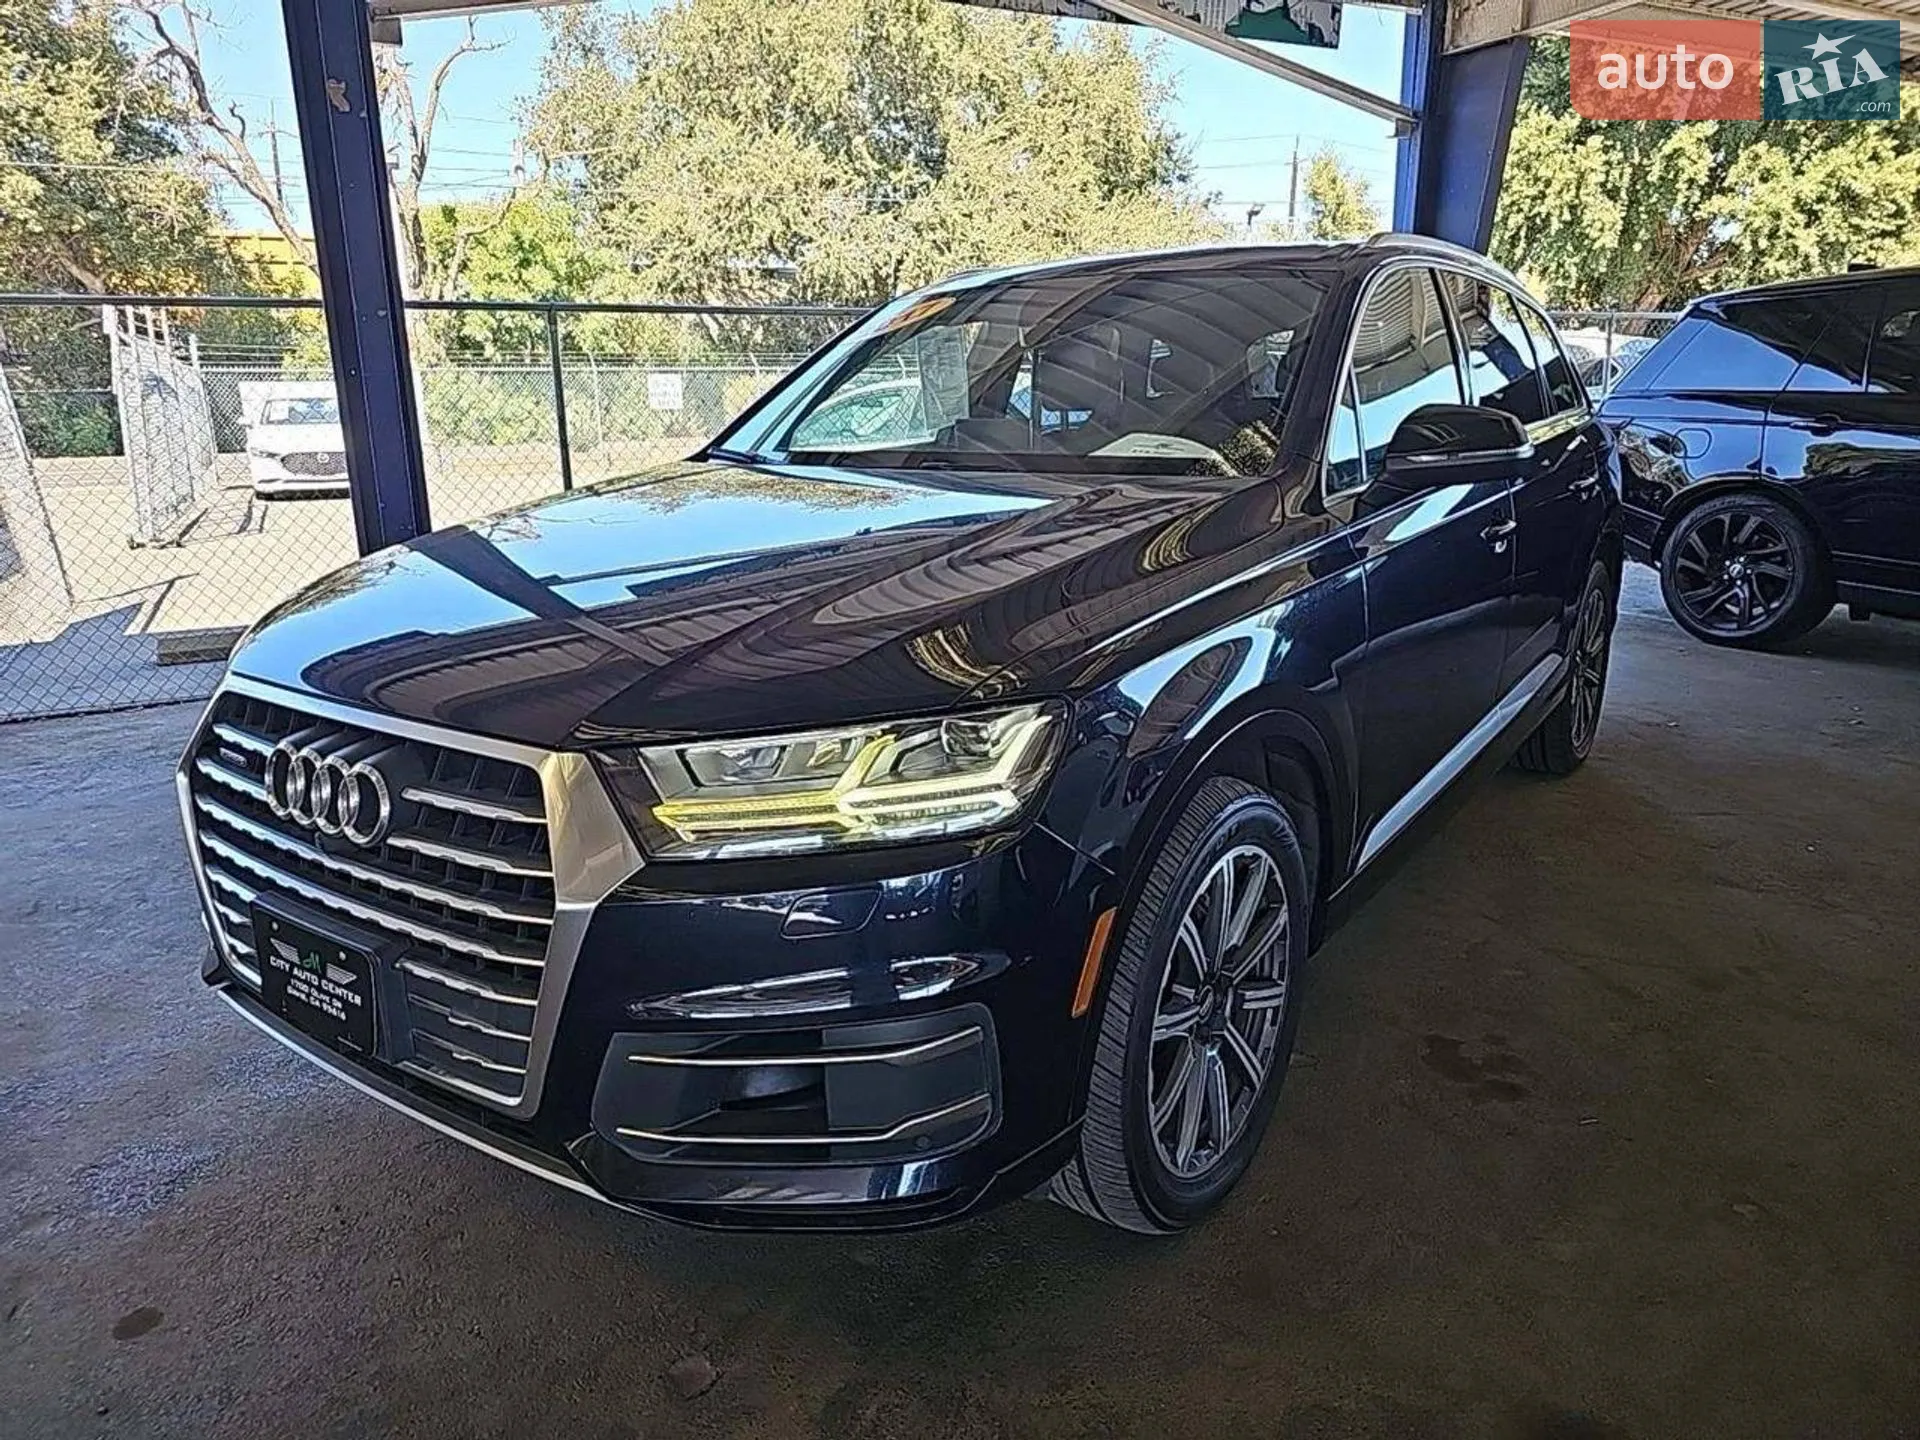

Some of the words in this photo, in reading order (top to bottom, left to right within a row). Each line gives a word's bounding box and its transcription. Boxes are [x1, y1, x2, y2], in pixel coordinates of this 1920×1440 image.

[270, 955, 290, 972] CITY
[293, 967, 319, 986] AUTO
[321, 979, 361, 1006] CENTER
